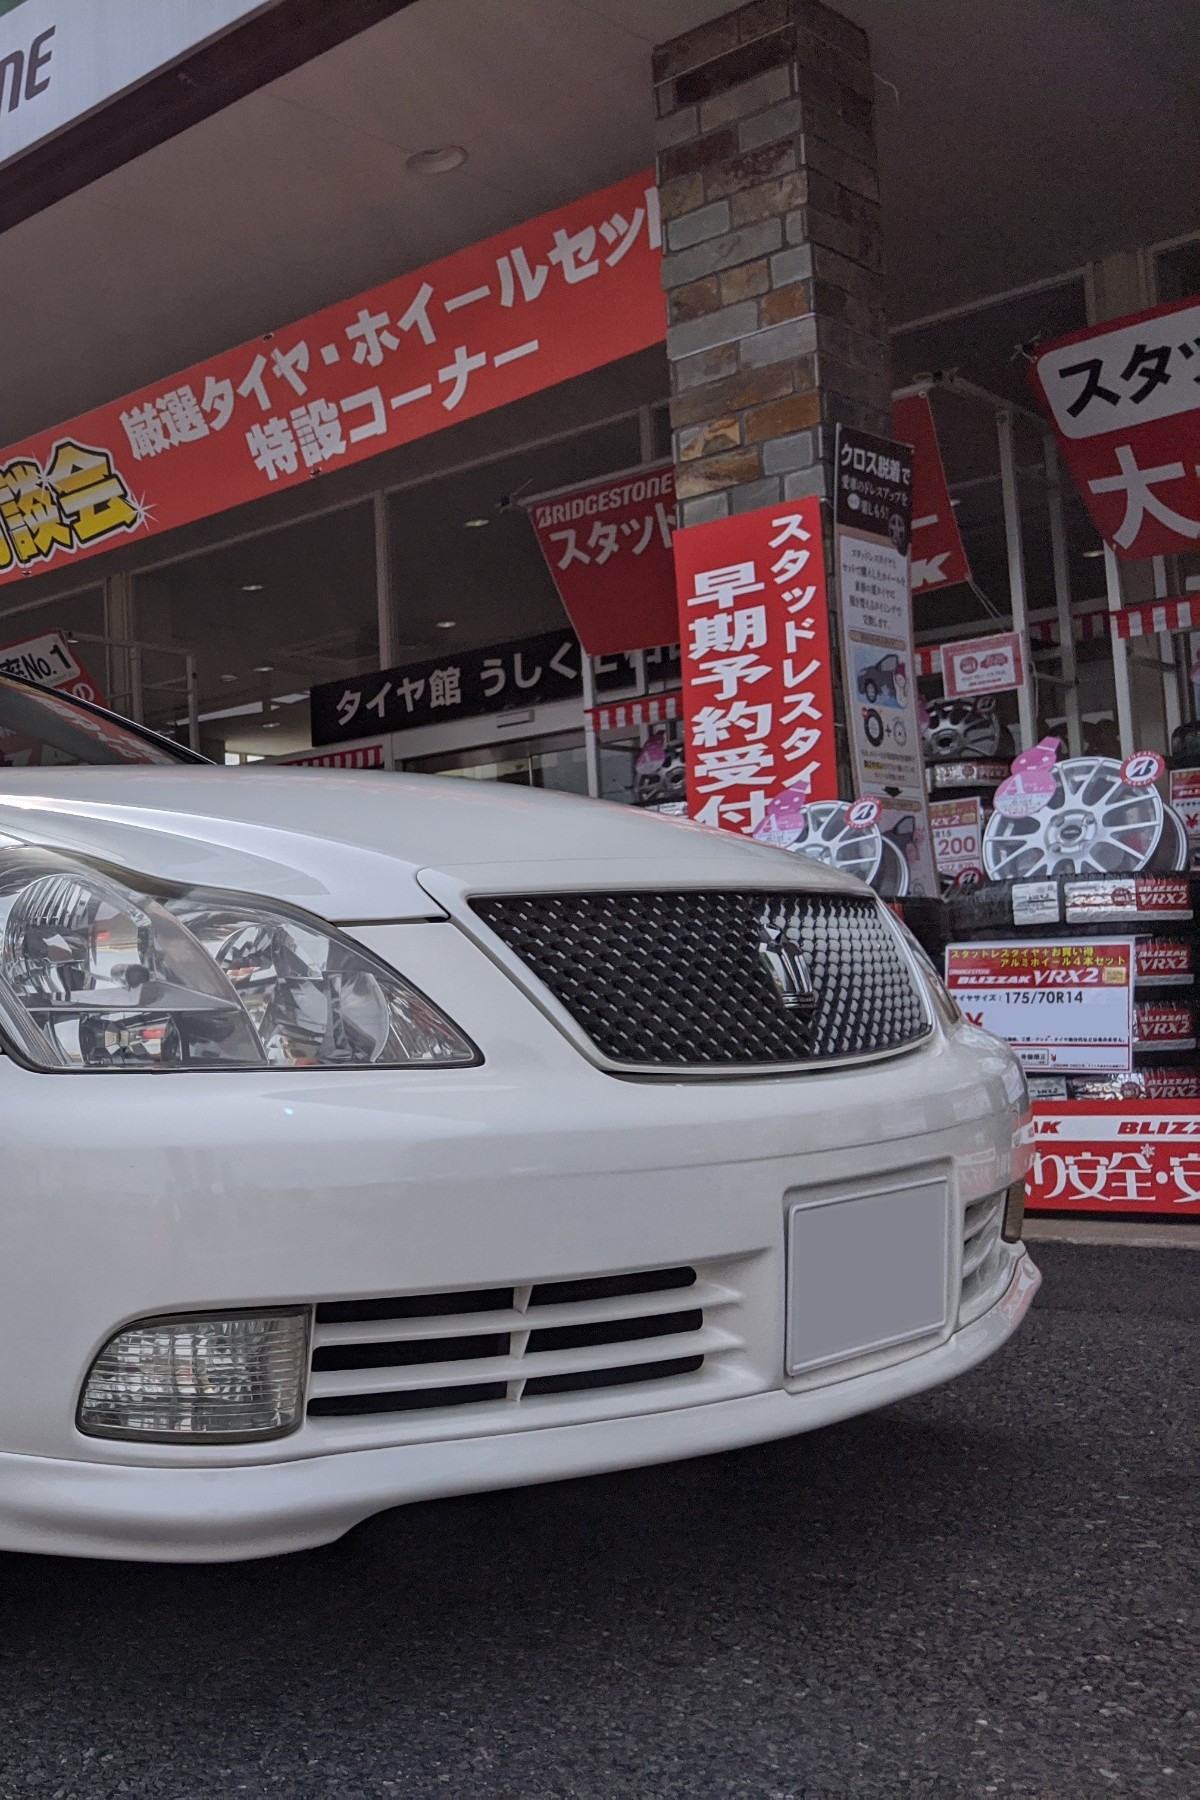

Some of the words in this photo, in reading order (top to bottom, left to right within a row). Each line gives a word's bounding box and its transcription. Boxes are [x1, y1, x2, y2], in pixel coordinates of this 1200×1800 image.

[245, 339, 539, 482] 特設コーナー
[535, 472, 675, 530] BRIDGESTONE
[334, 664, 464, 728] タイヤ館
[686, 560, 777, 835] 早期予約受付
[1140, 891, 1189, 906] VRX2
[1139, 956, 1190, 972] VRX2
[957, 974, 1031, 985] BLIZZAK
[1032, 967, 1099, 986] VRX2
[1004, 991, 1084, 1005] 175/70R14
[1141, 1020, 1191, 1037] VRX2
[1148, 1085, 1199, 1099] VRX2
